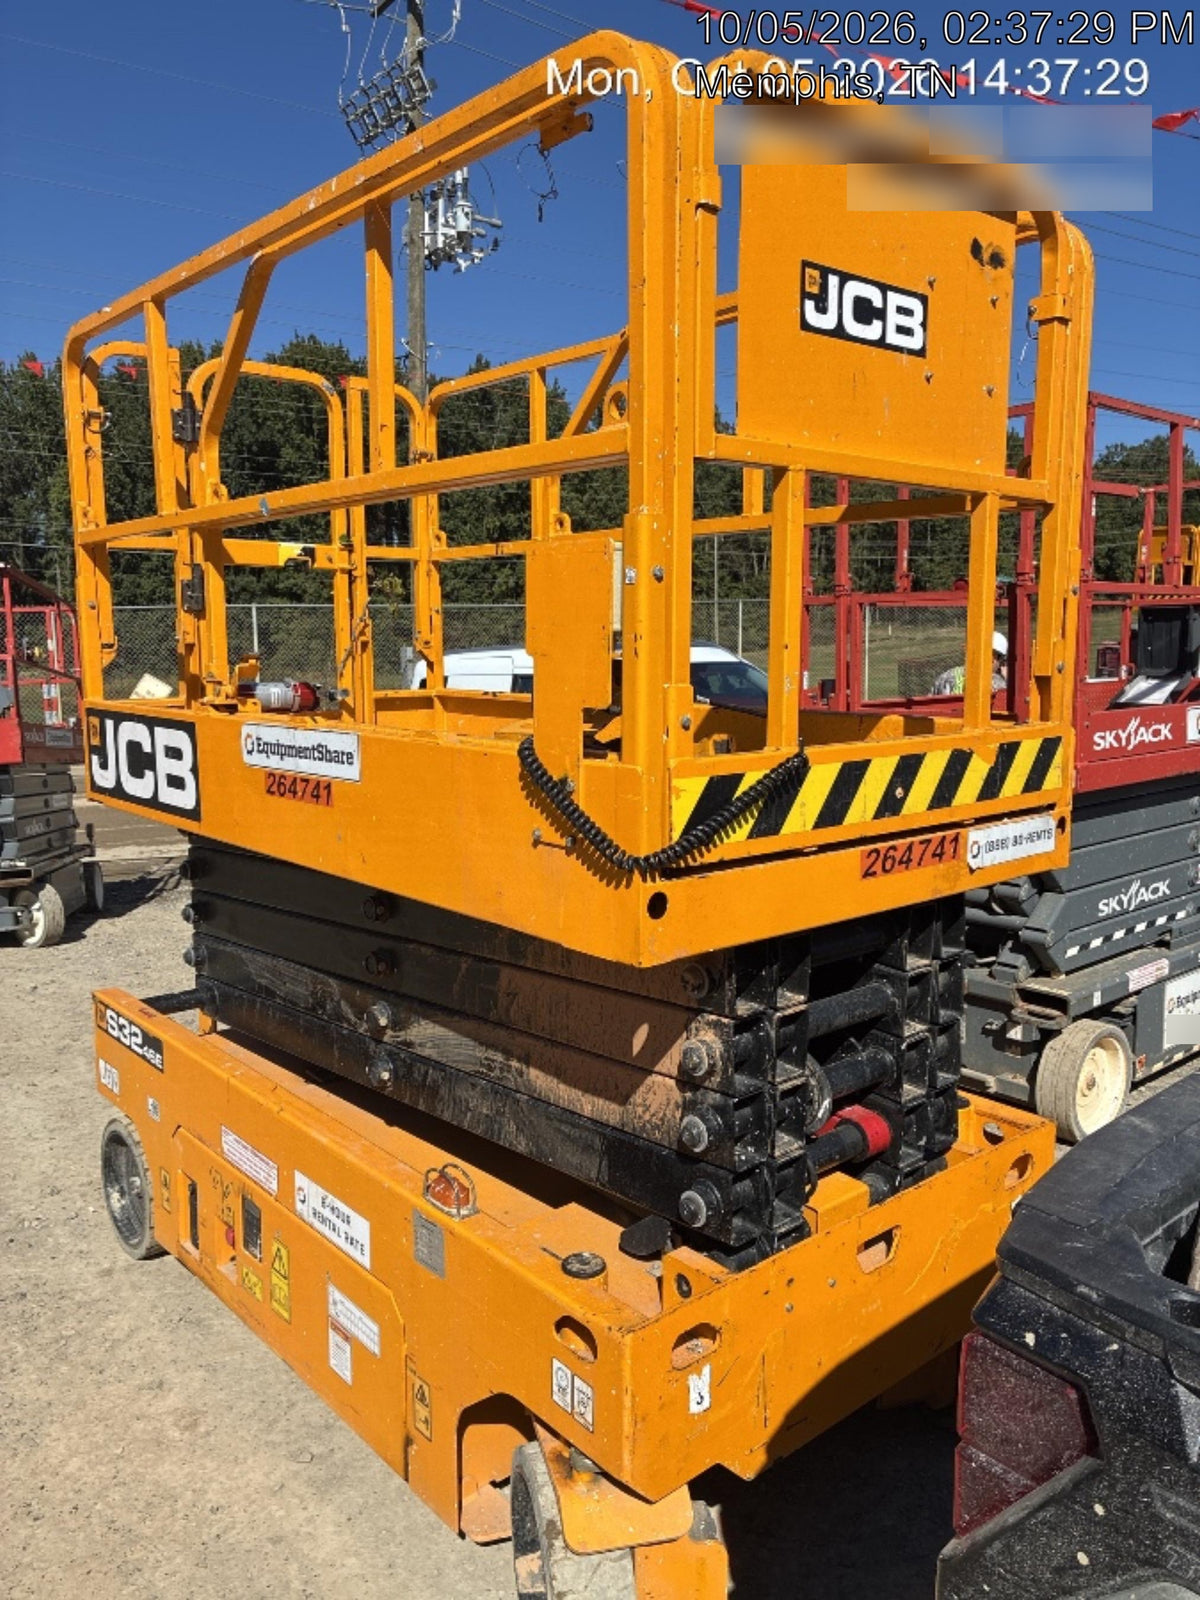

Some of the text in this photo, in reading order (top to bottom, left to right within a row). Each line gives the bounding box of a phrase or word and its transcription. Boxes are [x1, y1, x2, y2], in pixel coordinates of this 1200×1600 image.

[803, 272, 925, 351] JCB
[255, 736, 355, 766] EquipmentShare
[1092, 715, 1174, 751] SKYJACK
[90, 717, 197, 810] JCB
[265, 772, 332, 806] 264741
[862, 831, 961, 879] 264741
[1097, 877, 1172, 918] SKYJACK
[311, 1207, 342, 1238] RENTAL
